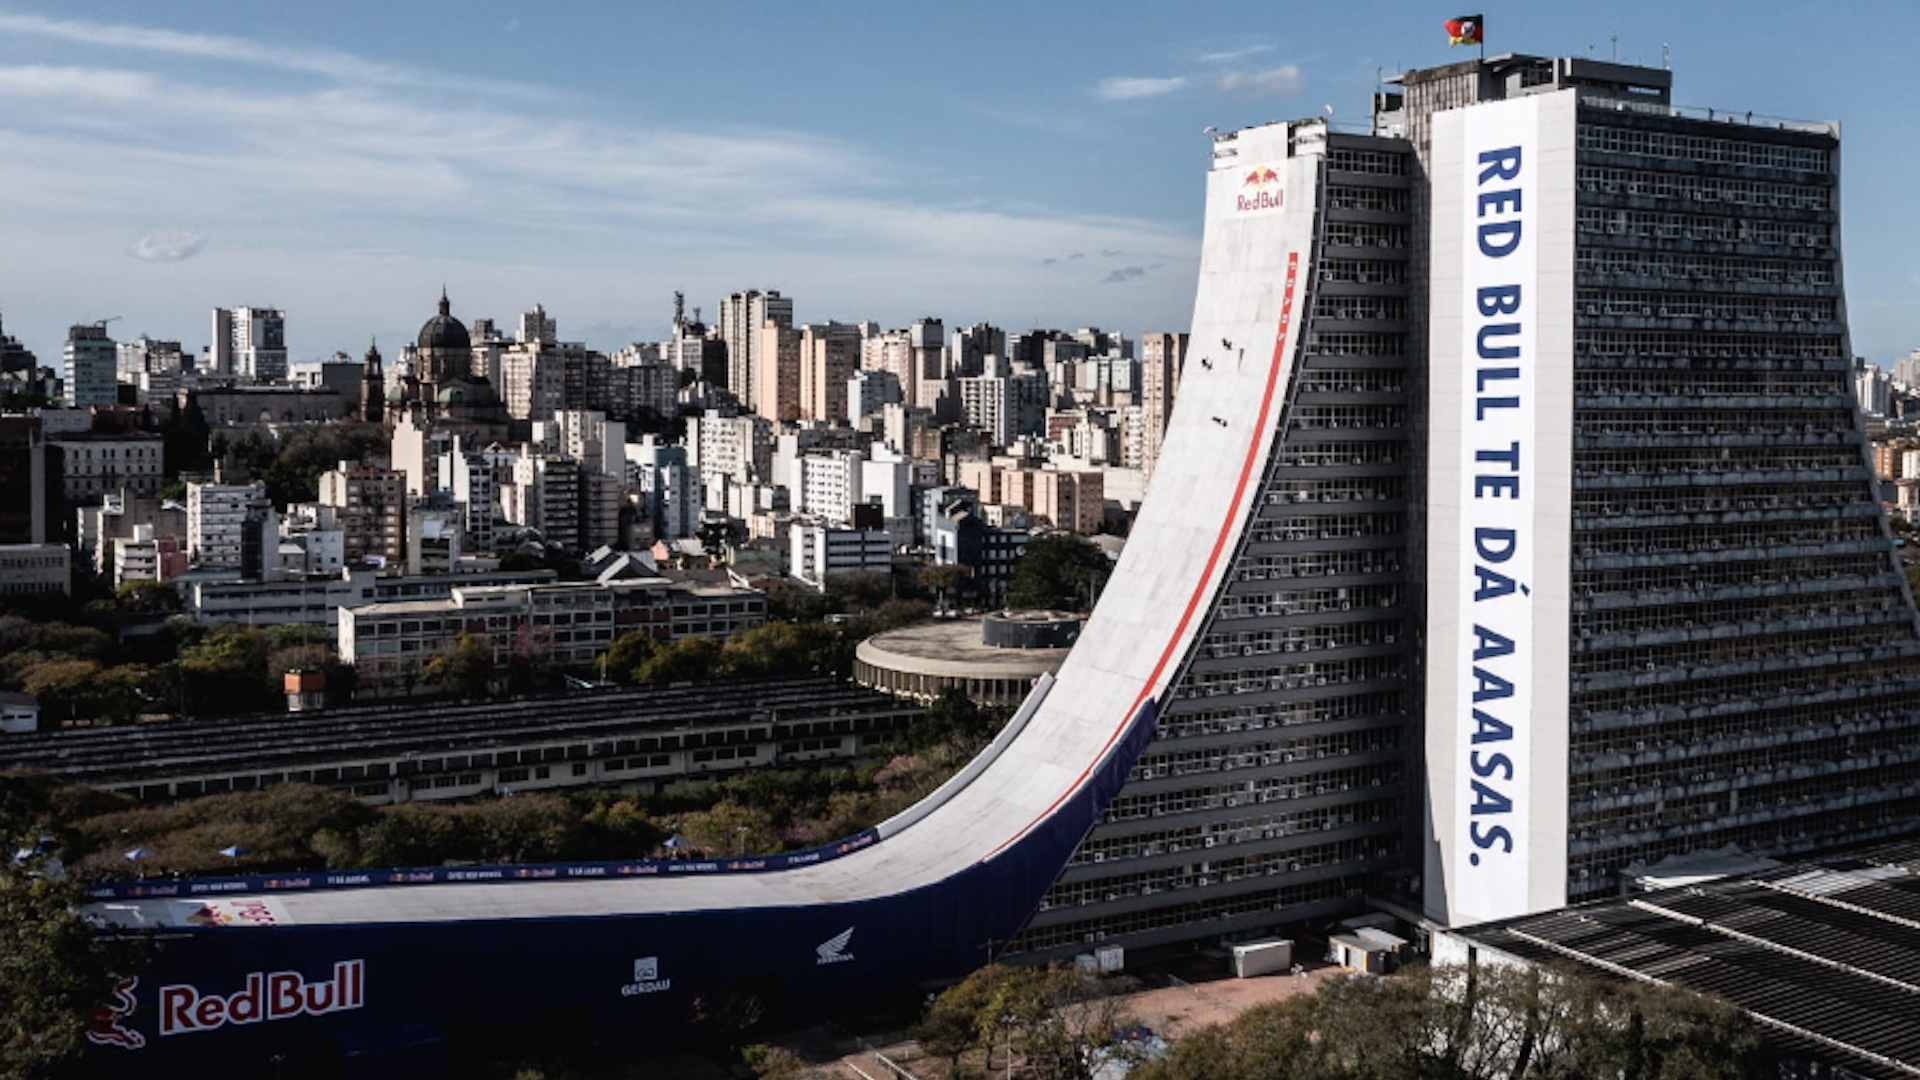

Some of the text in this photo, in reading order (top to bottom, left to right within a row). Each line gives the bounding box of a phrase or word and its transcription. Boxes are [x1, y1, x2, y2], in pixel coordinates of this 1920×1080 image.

[1237, 188, 1284, 211] Red Bull
[1469, 145, 1531, 867] RED BULL TE DÁ AAASAS.
[159, 959, 364, 1036] Red Bull
[621, 978, 671, 997] GERDAU
